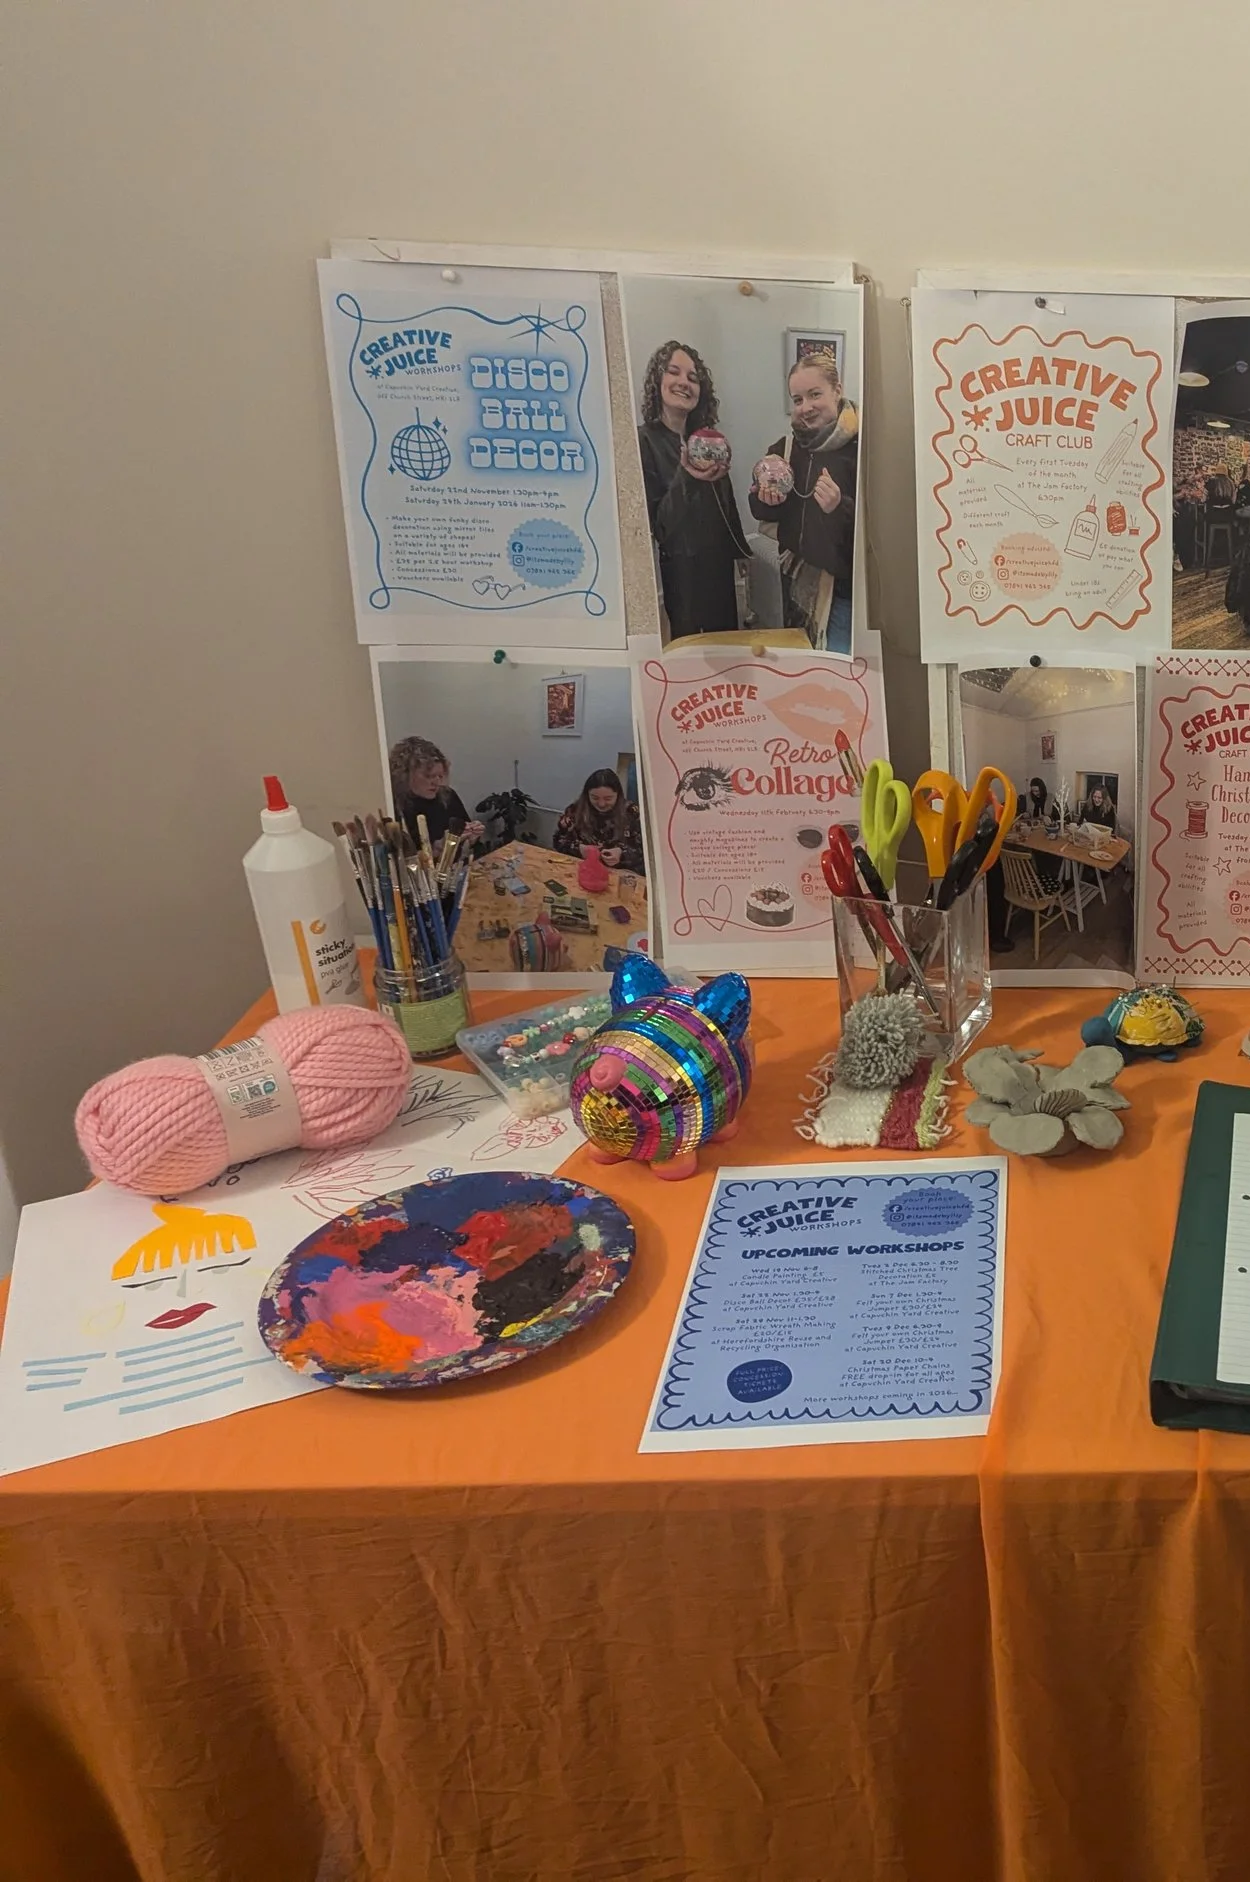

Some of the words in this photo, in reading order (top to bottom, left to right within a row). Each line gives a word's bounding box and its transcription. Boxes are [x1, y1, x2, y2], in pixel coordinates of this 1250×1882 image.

[359, 329, 452, 365] CREATIVE
[384, 348, 438, 376] JUICE
[405, 364, 462, 375] WORKSHOPS
[469, 357, 570, 392] DISCO
[960, 356, 1137, 411] CREATIVE
[481, 397, 567, 432] BALL
[995, 396, 1099, 431] JUICE
[1005, 433, 1052, 448] CRAFT
[1056, 435, 1093, 449] CLUB
[468, 437, 585, 472] DECOR
[1016, 458, 1037, 467] Every
[1039, 458, 1057, 466] first
[1059, 459, 1089, 468] Tuesday
[410, 485, 444, 494] Saturday
[470, 487, 510, 496] November
[1060, 483, 1088, 492] Factory
[405, 496, 439, 506] Saturday
[464, 499, 495, 508] January
[671, 684, 758, 722] CREATIVE
[694, 701, 745, 730] JUICE
[713, 714, 767, 728] WORKSHOPS
[763, 738, 837, 765] Retro
[1219, 749, 1247, 758] CRAFT
[1218, 833, 1248, 843] Tuesday
[315, 938, 346, 957] sticky
[736, 1196, 858, 1229] CREATIVE
[764, 1209, 835, 1235] JUICE
[789, 1218, 862, 1233] WORKSHOPS
[741, 1246, 839, 1260] UPCOMING
[847, 1240, 965, 1256] WORKSHOPS
[841, 1373, 865, 1381] FREE
[830, 1394, 880, 1402] workshops
